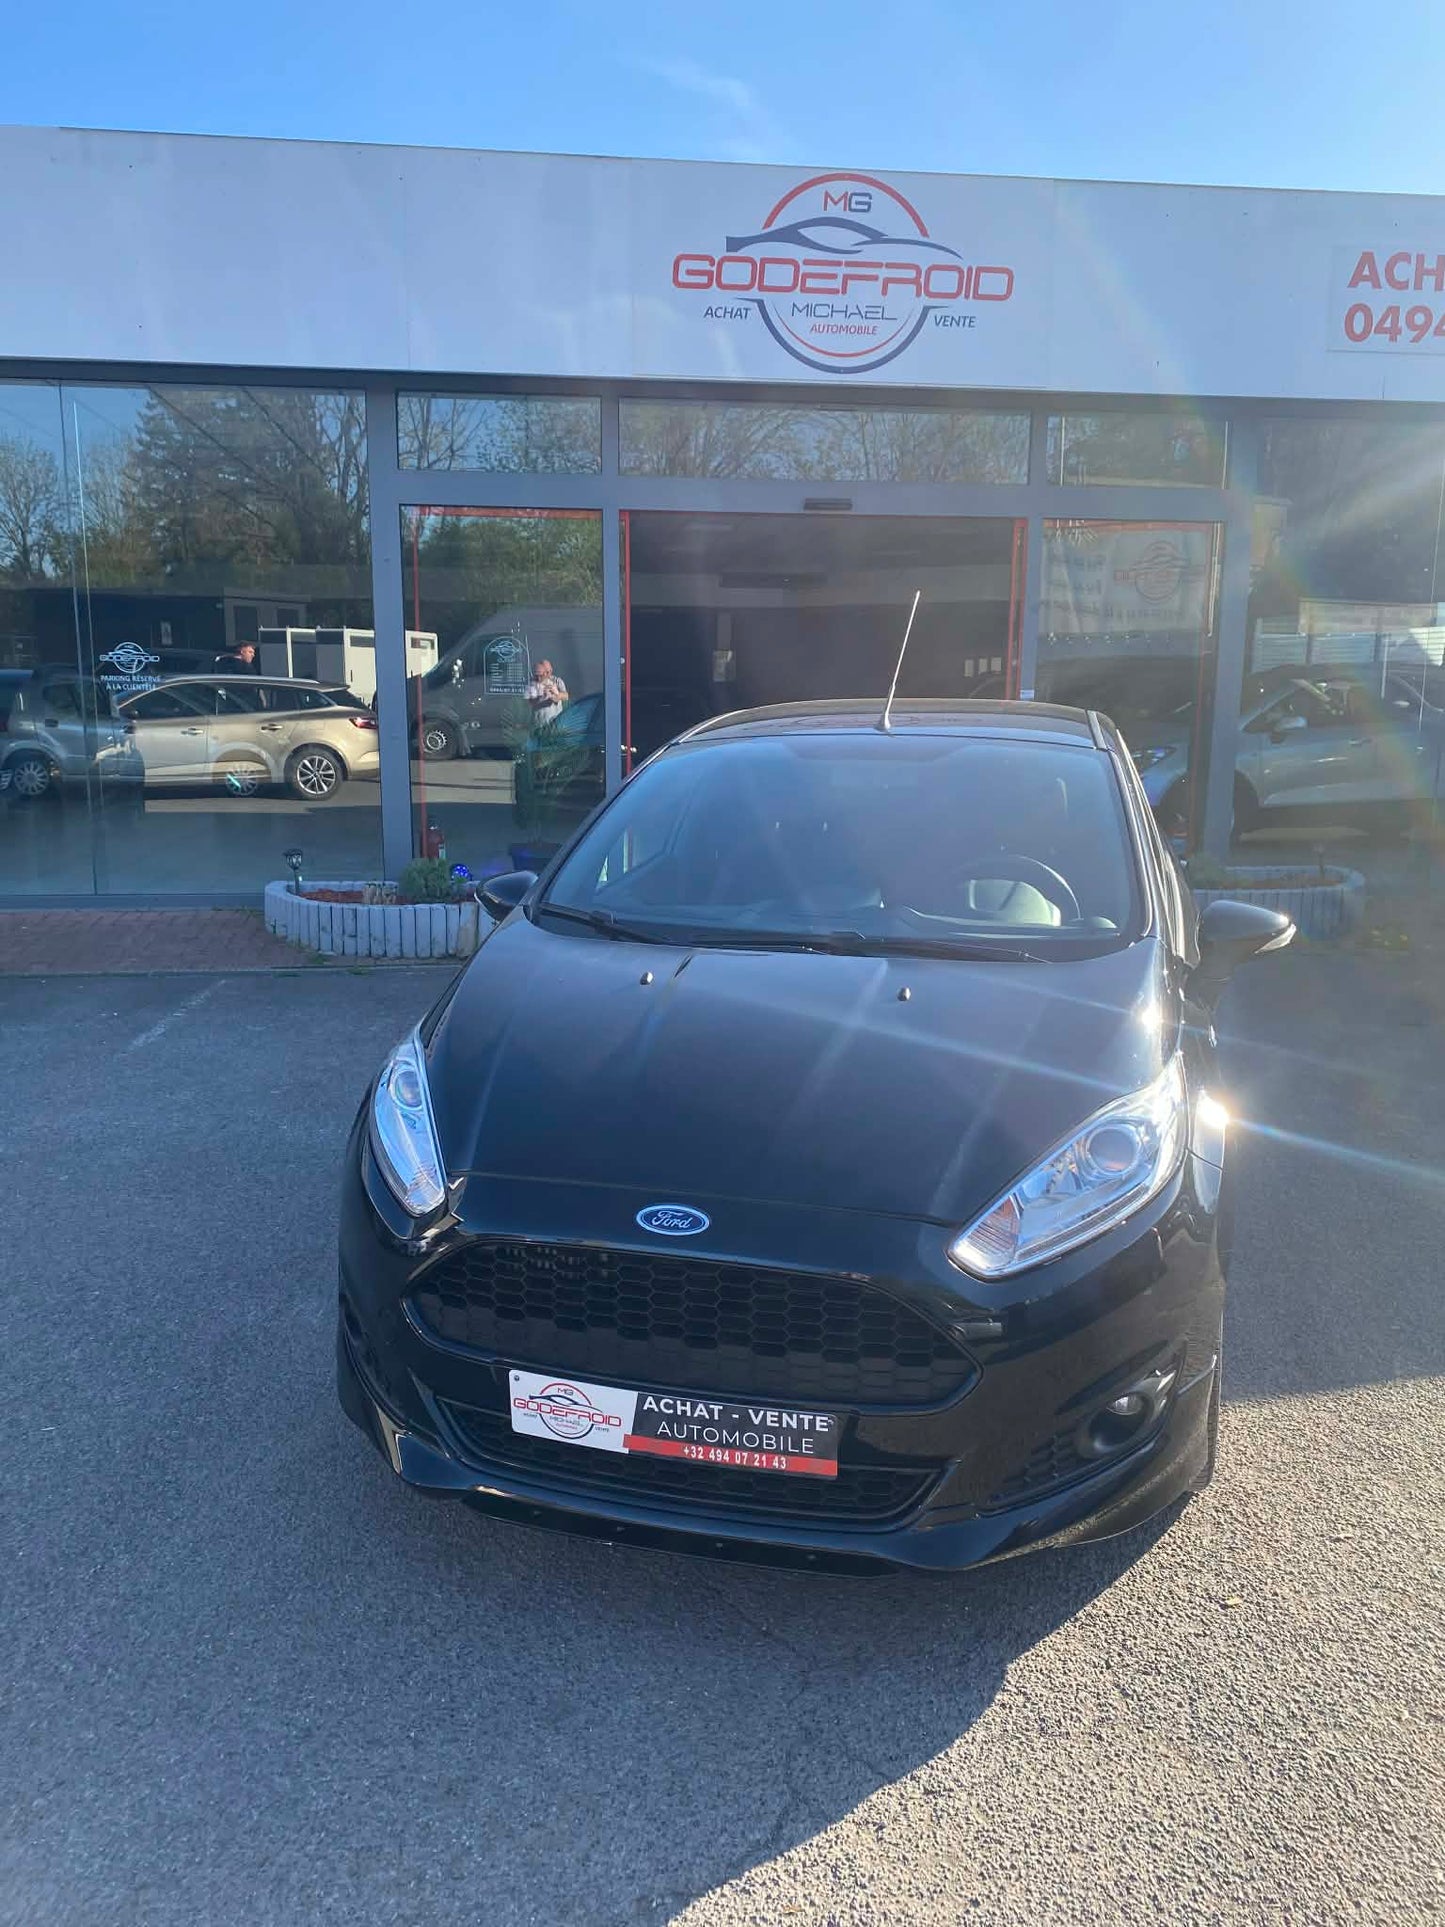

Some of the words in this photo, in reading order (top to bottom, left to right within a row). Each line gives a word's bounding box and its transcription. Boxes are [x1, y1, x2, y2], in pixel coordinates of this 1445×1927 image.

[823, 190, 872, 213] MG
[672, 253, 1014, 301] GODEFROID
[1347, 251, 1445, 291] ACH
[703, 306, 751, 321] ACHAT
[791, 303, 897, 321] MICHAEL
[934, 315, 976, 330] VENTE
[809, 323, 878, 337] AUTOMOBILE
[652, 1210, 694, 1229] Ford
[513, 1397, 622, 1427] GODEFROID
[643, 1395, 723, 1420] ACHAT
[748, 1409, 829, 1432] VENTE
[657, 1421, 814, 1454] AUTOMOBILE
[684, 1446, 704, 1460] +32
[709, 1448, 730, 1462] 494
[735, 1451, 748, 1465] 07
[753, 1453, 767, 1467] 21
[772, 1455, 787, 1470] 43
